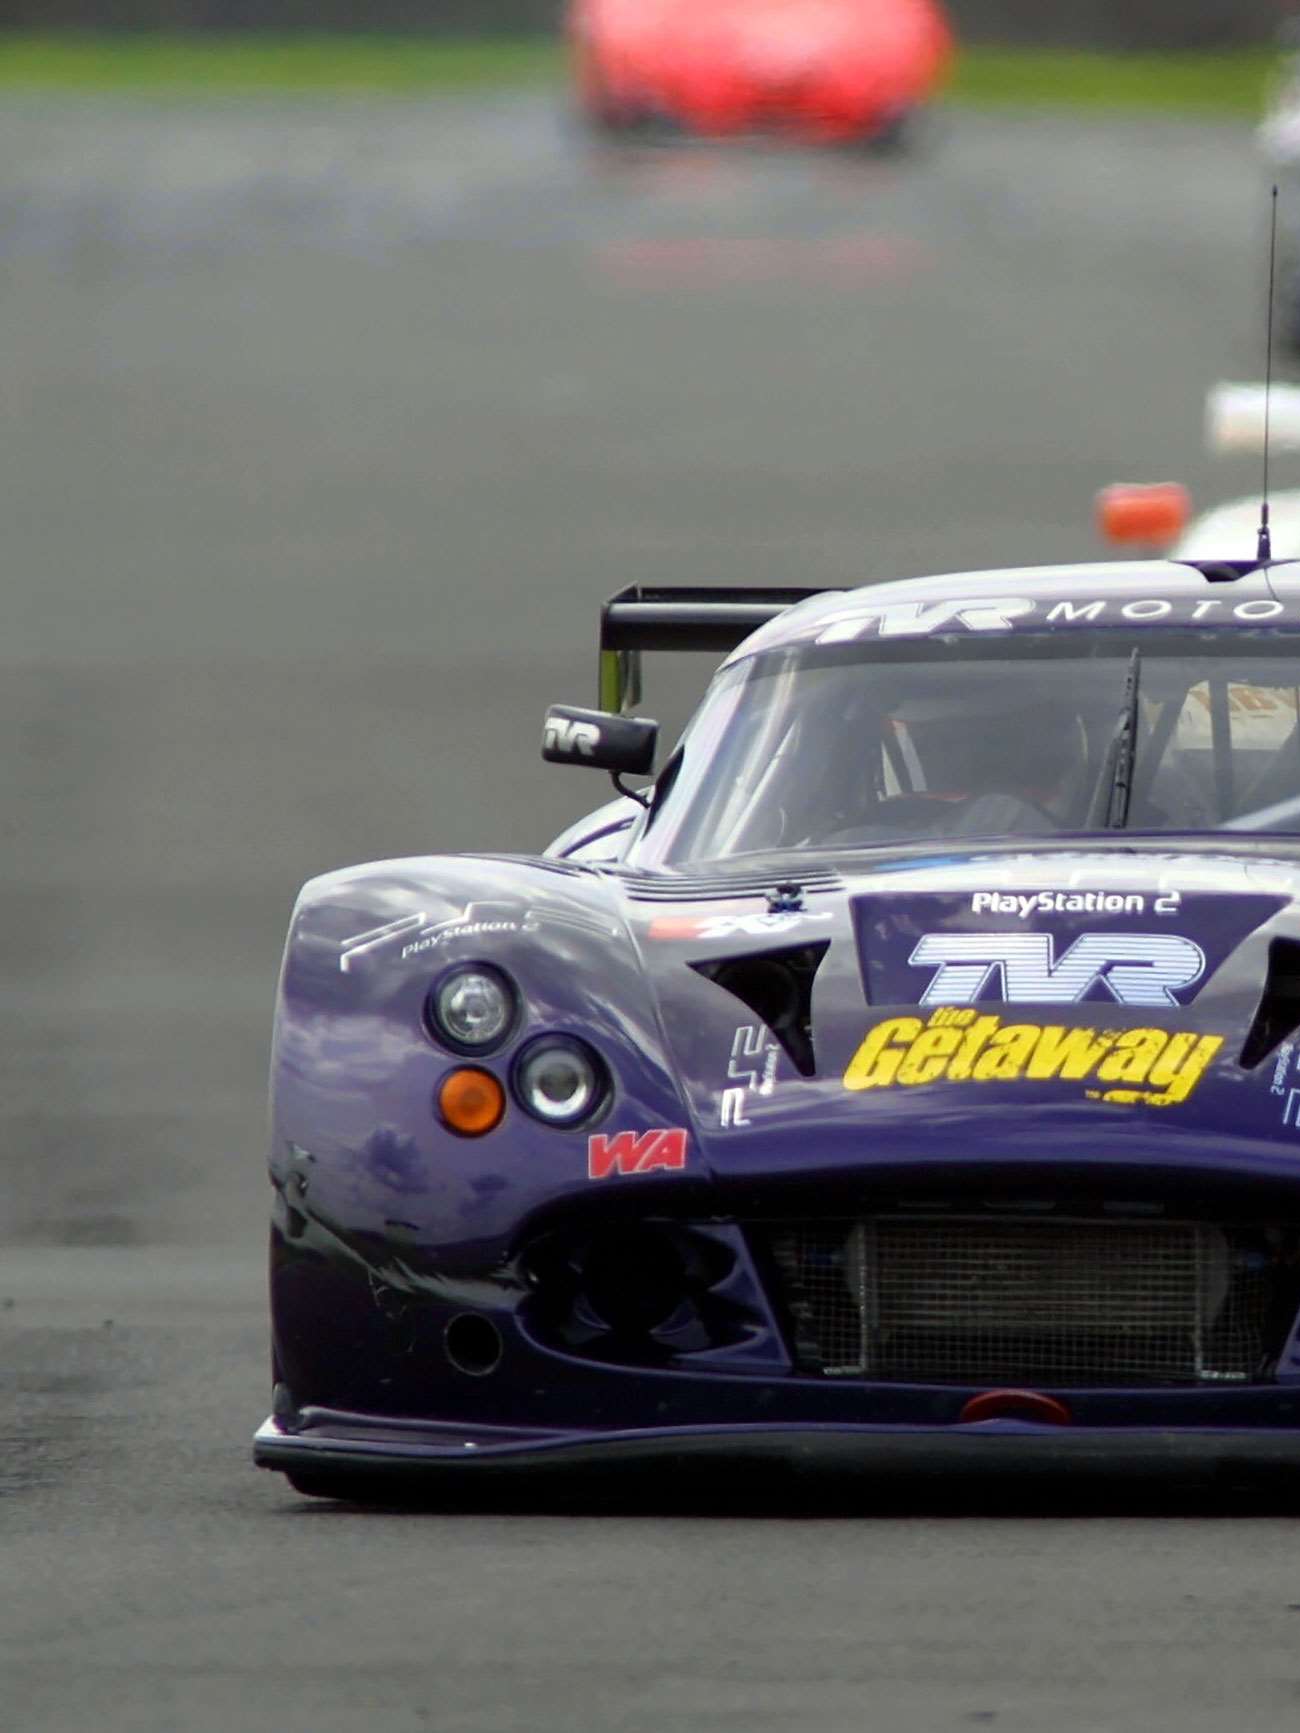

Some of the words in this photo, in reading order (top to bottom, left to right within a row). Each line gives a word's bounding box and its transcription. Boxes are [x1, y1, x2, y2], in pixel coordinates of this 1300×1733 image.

[813, 598, 1037, 645] TVR
[971, 890, 1145, 918] PlayStation
[1153, 890, 1182, 914] 2
[907, 932, 1207, 1009] TVR
[927, 1005, 978, 1027] the
[843, 1015, 1226, 1107] Getaway
[588, 1127, 688, 1179] WA
